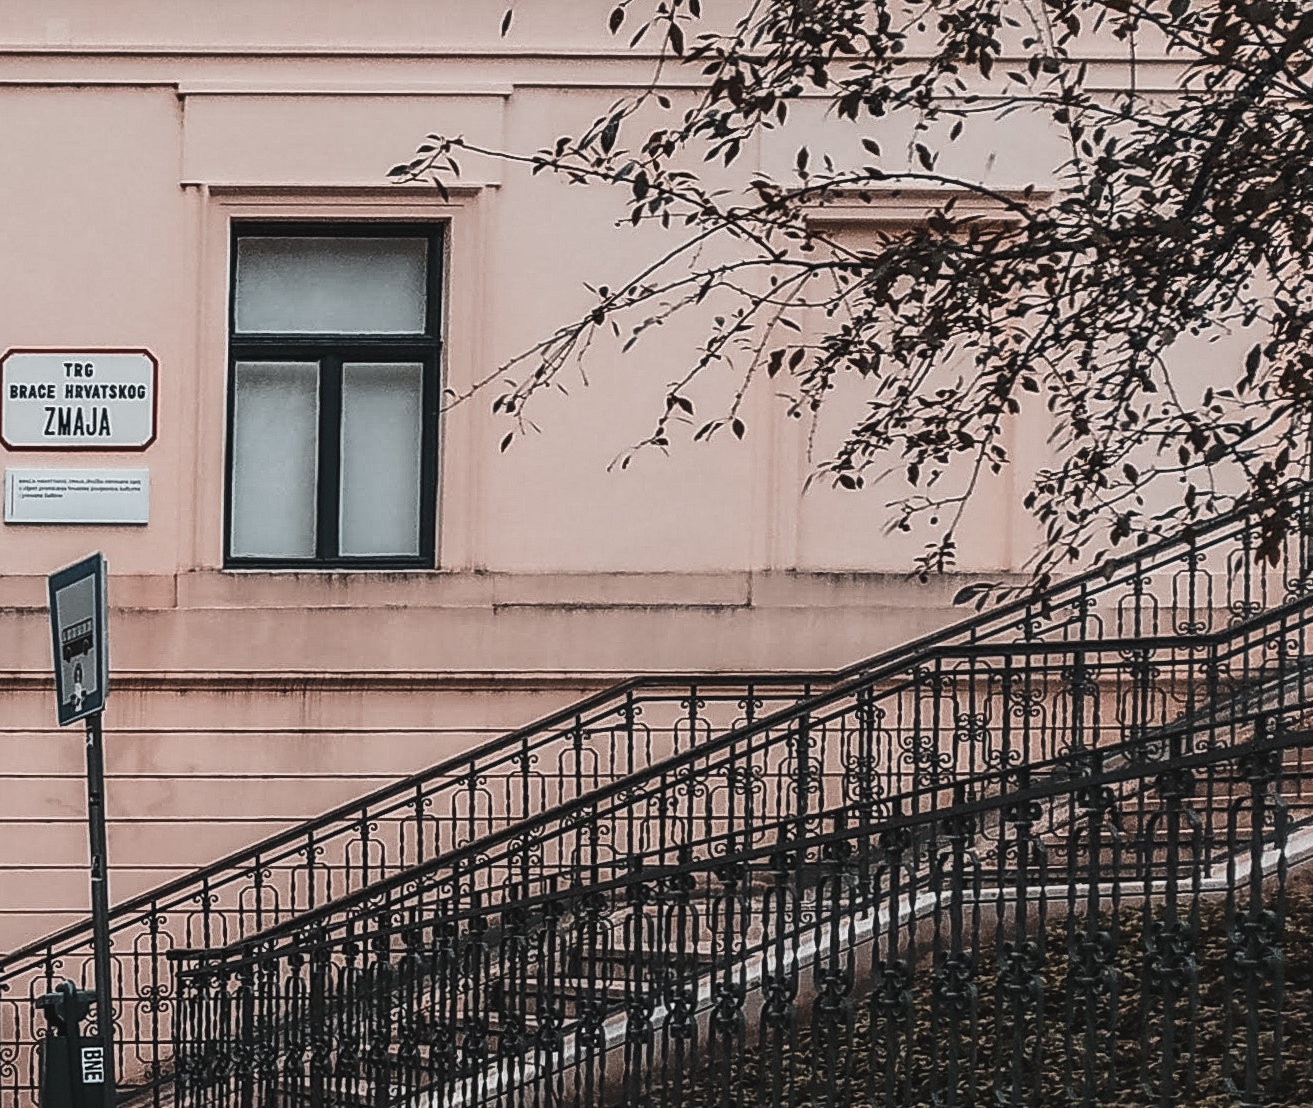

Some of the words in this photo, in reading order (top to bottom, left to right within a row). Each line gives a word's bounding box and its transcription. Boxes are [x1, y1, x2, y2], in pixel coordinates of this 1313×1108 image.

[63, 362, 94, 378] TRG
[64, 384, 146, 400] HRVATSKOG
[43, 406, 112, 436] ZMAJA
[84, 1049, 104, 1082] BNE
